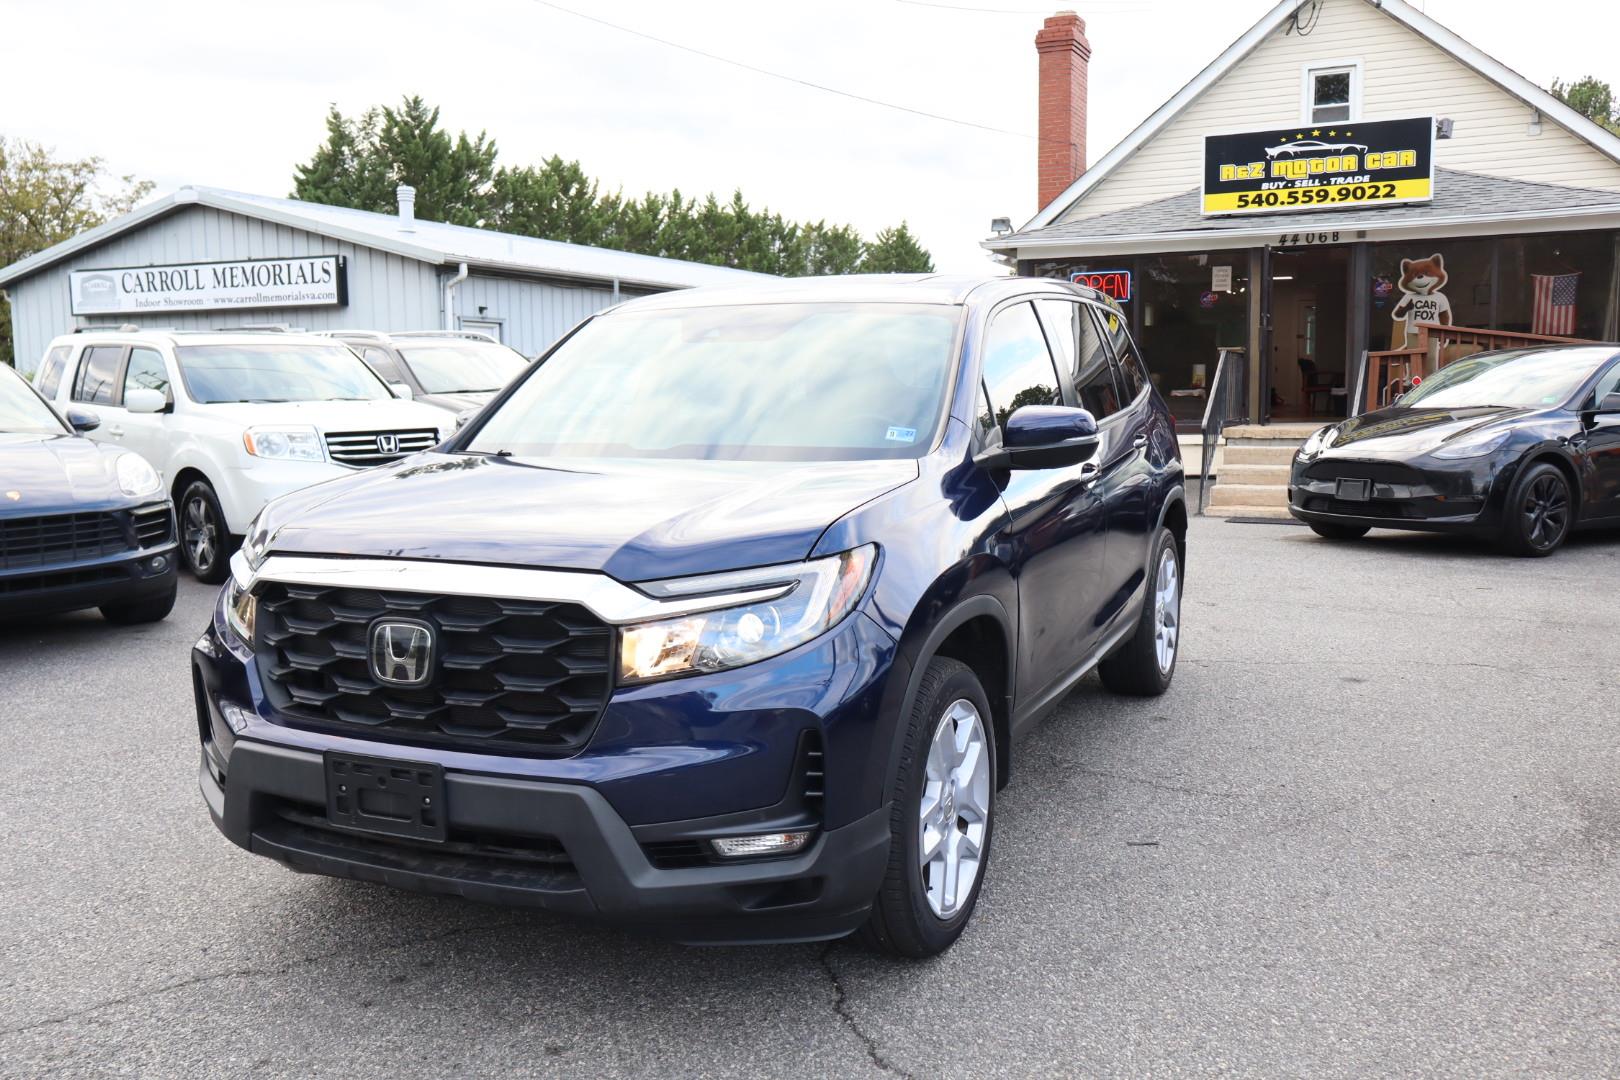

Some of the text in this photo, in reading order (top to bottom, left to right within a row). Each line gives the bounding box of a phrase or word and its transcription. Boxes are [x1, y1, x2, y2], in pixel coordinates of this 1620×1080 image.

[1261, 175, 1371, 190] BUY SELL TRADE
[1237, 184, 1396, 208] 540.559.9022
[1279, 232, 1339, 245] 4406B
[121, 260, 332, 294] CARROLL MEMORIALS
[135, 291, 335, 307] Indoor Showroom www.carrollmemorialsva.com
[1414, 300, 1437, 310] CAR
[1414, 310, 1436, 320] FOX
